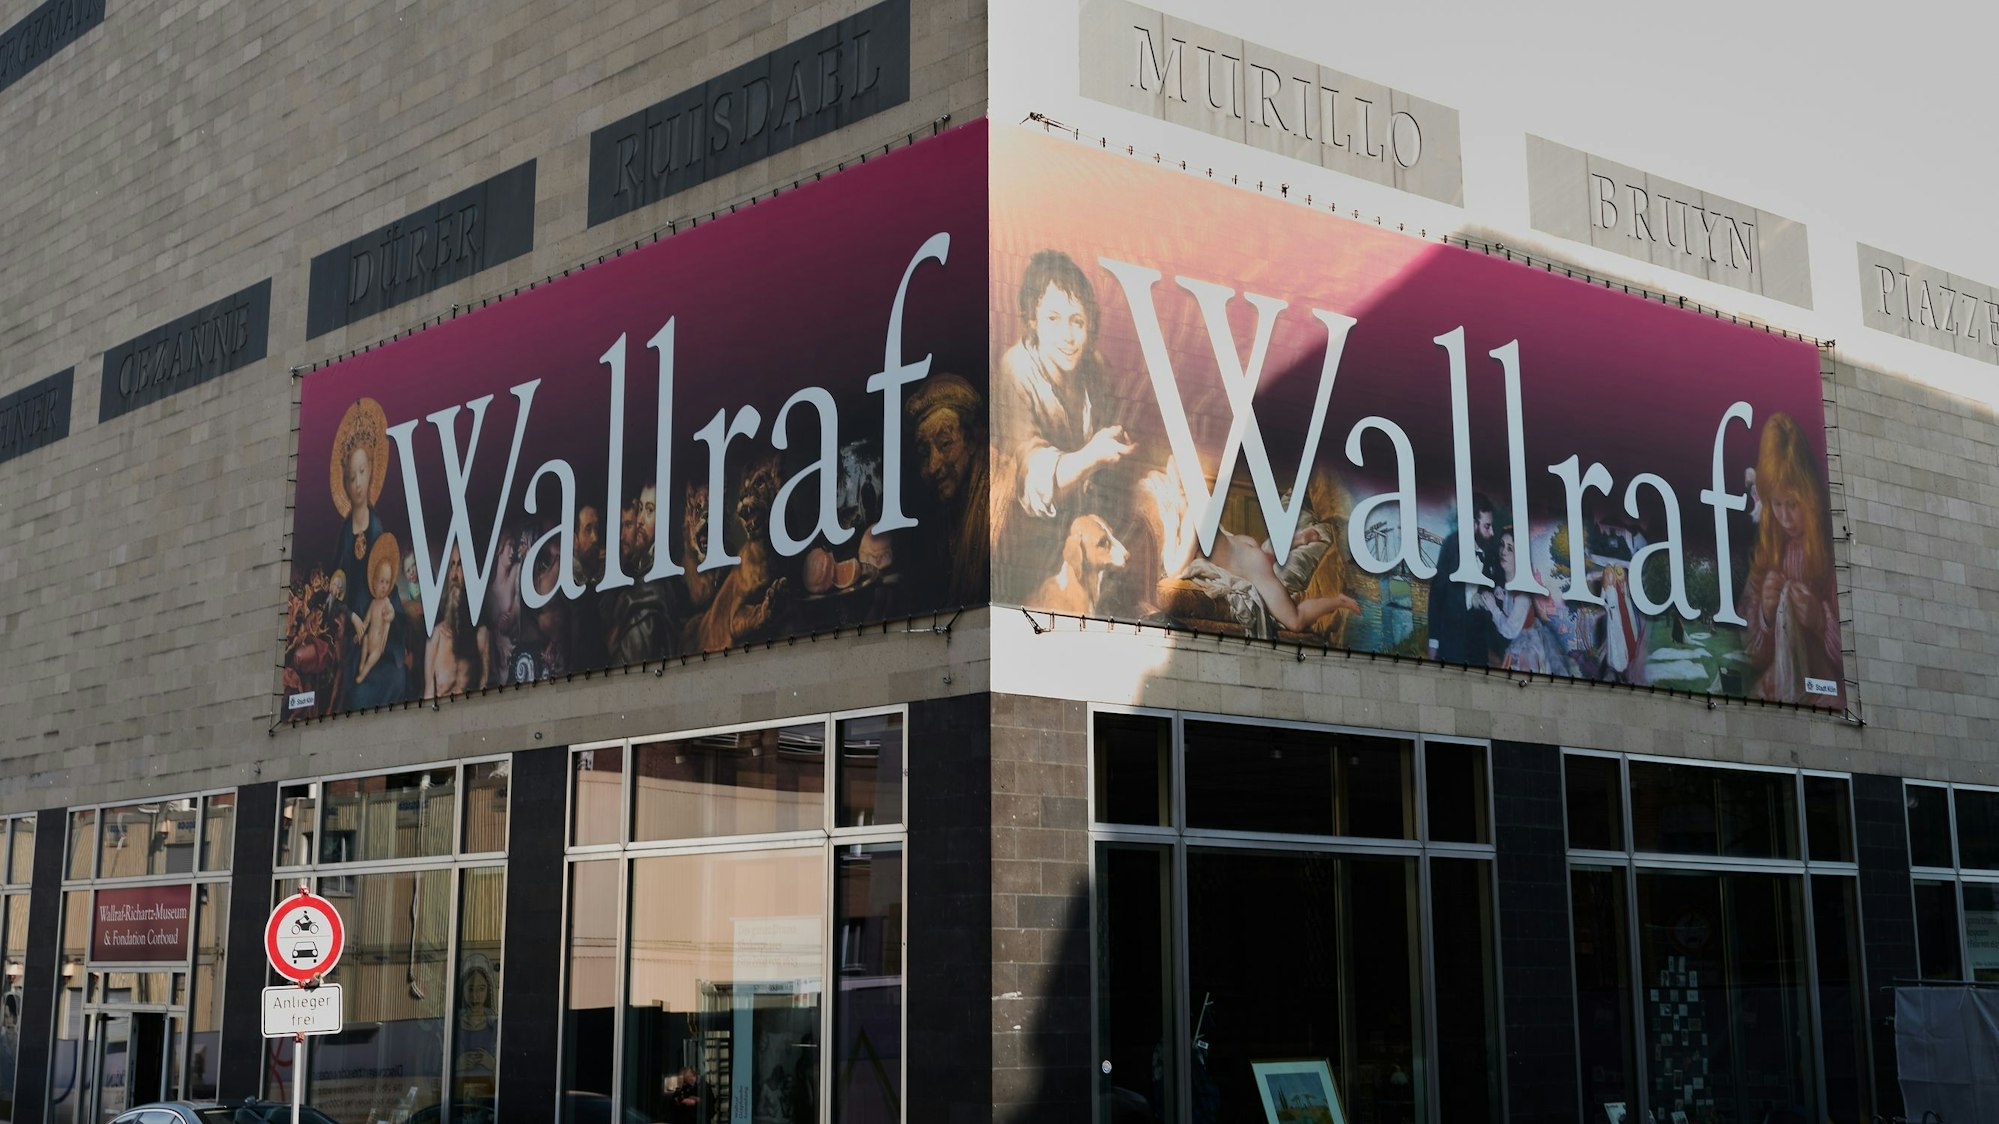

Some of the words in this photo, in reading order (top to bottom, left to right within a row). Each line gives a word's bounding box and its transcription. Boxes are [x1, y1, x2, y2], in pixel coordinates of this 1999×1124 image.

[613, 29, 880, 198] RUISDAEL
[1130, 25, 1422, 169] MURILLO
[349, 203, 481, 306] DÜRER
[1591, 173, 1754, 274] BRUYN
[119, 302, 250, 399] CEZANNE
[386, 231, 950, 638] Wallraf
[1098, 257, 1753, 627] Wallraf
[99, 902, 187, 922] Wallraf-Richartz-Museum
[103, 929, 112, 946] &
[112, 928, 146, 946] Fondation
[147, 927, 179, 945] Corboud
[273, 995, 332, 1011] Anlieger
[291, 1013, 316, 1027] frei
